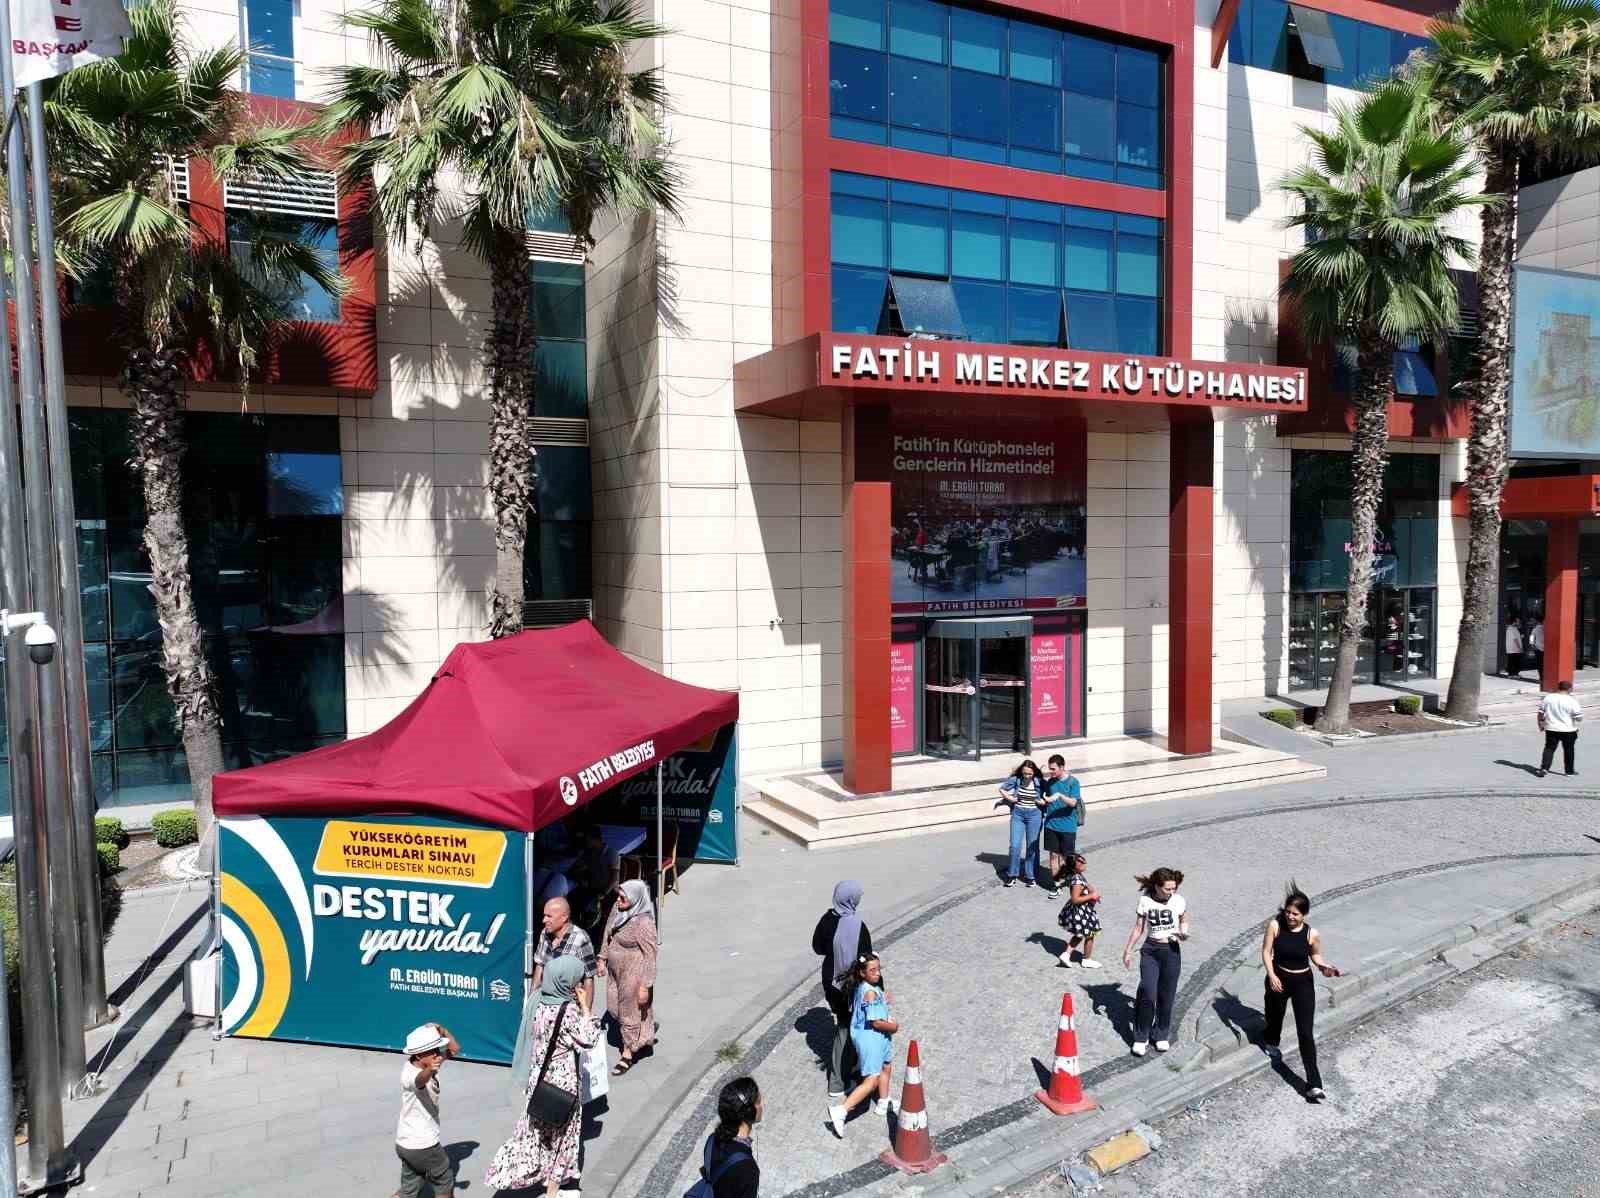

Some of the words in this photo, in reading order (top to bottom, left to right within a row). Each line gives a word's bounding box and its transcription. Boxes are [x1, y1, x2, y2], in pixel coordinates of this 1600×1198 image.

[12, 39, 93, 60] BAŞKAN
[831, 342, 940, 380] FATİH
[955, 352, 1091, 388] MERKEZ
[1102, 359, 1305, 401] KÜTÜPHANESİ
[893, 436, 950, 453] Fatih'in
[953, 438, 1055, 457] Kütüphaneleri
[893, 456, 967, 474] Gençlerin
[970, 458, 1055, 475] Hizmetinde!
[927, 601, 959, 611] FATİH
[963, 600, 1024, 610] BELEDİYESİ
[577, 758, 614, 791] FATİH
[610, 739, 655, 773] BELEDİYESİ
[350, 829, 467, 848] YÜKSEKÖĞRETİM
[343, 845, 424, 861] KURUMLARI
[429, 851, 476, 865] SINAVI
[345, 858, 382, 870] TERCİH
[385, 861, 424, 873] DESTEK
[428, 865, 475, 878] NOKTASI
[313, 884, 455, 927] DESTEK
[360, 912, 507, 966] yanında!
[390, 967, 404, 982] M.
[406, 968, 442, 987] ERGÜN
[443, 972, 478, 991] TURAN
[446, 988, 479, 1000] BAŞKANI
